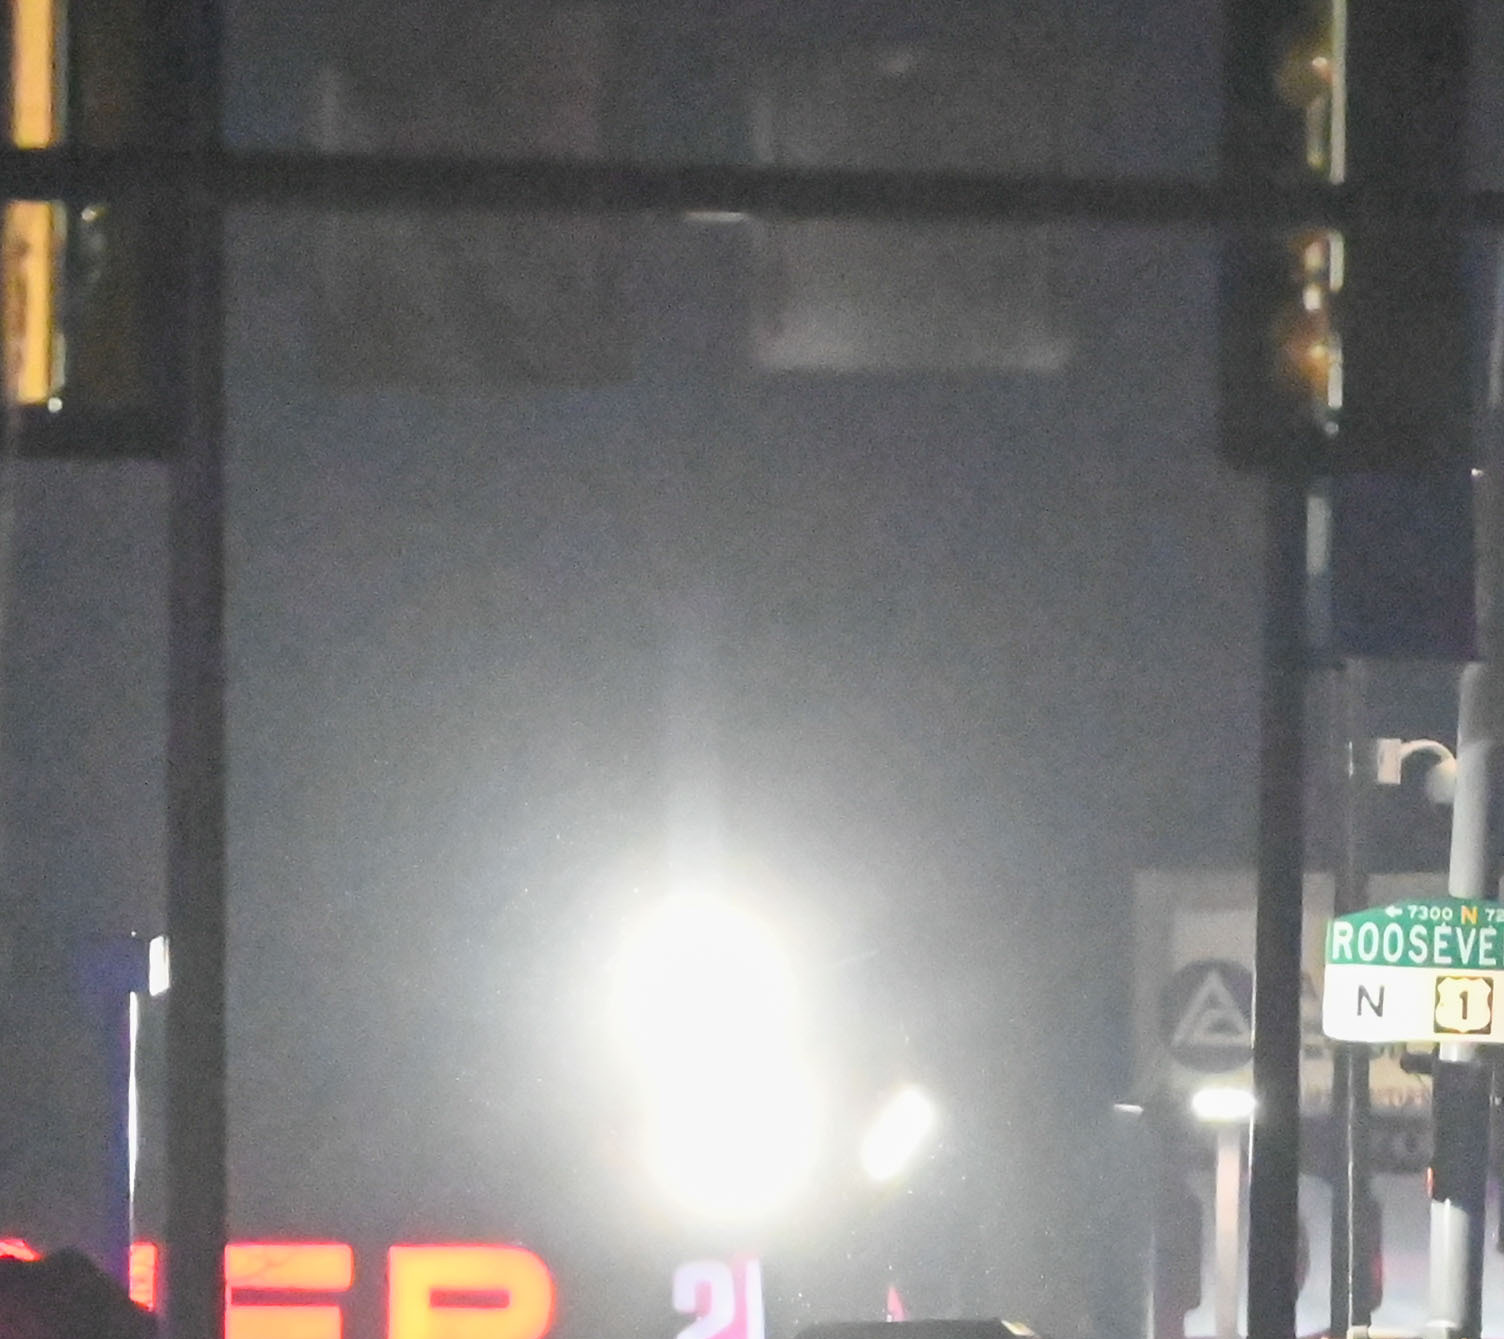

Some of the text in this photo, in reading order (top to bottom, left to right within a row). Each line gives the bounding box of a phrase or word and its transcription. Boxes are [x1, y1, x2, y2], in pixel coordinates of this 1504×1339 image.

[1407, 905, 1453, 921] 7300
[1461, 905, 1478, 924] N
[1356, 984, 1385, 1018] N
[1458, 990, 1469, 1021] 1
